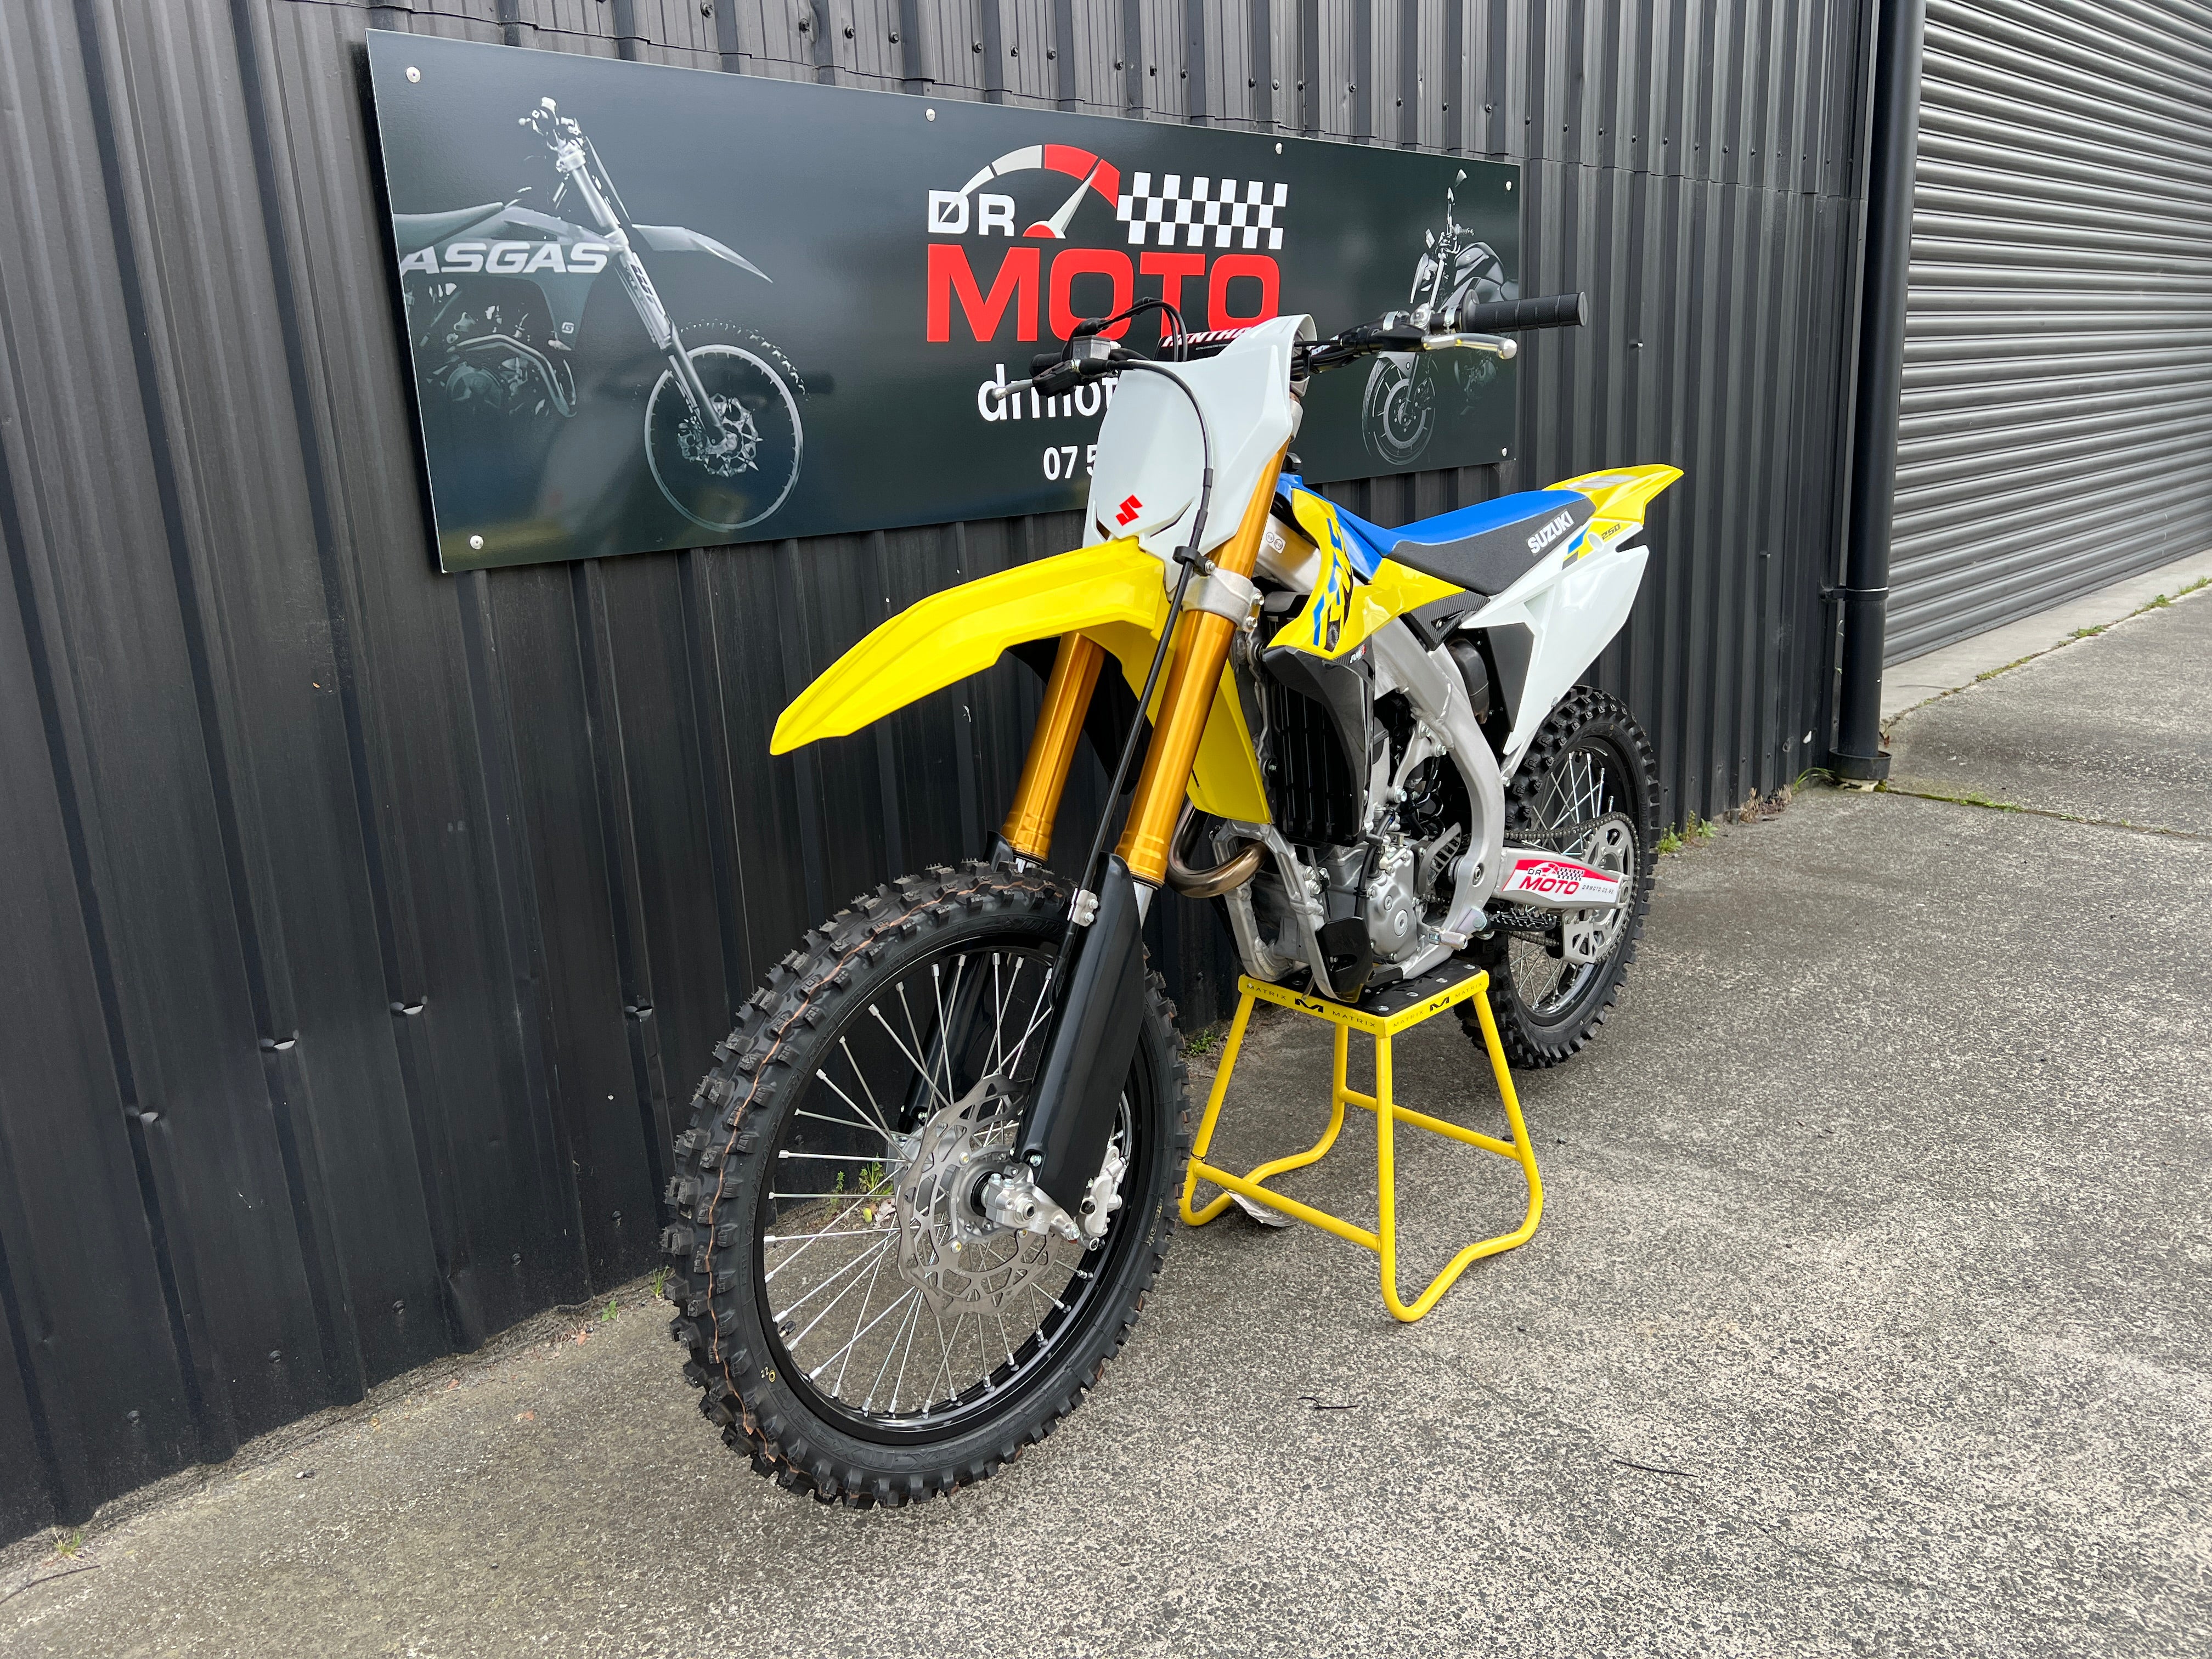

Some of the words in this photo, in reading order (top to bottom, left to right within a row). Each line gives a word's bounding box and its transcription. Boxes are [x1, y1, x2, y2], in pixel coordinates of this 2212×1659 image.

[928, 190, 1015, 236] DR
[400, 242, 610, 275] ASGAS
[927, 244, 1280, 342] MOTO
[1043, 445, 1078, 480] 07
[1527, 510, 1574, 554] SUZUKI
[1601, 523, 1621, 540] 250
[1519, 876, 1579, 895] MOTO
[1247, 984, 1286, 1000] MATRIX
[1333, 1011, 1375, 1028] MATRIX
[1393, 1010, 1423, 1028] MATRIX
[1455, 982, 1482, 998] MATRIX
